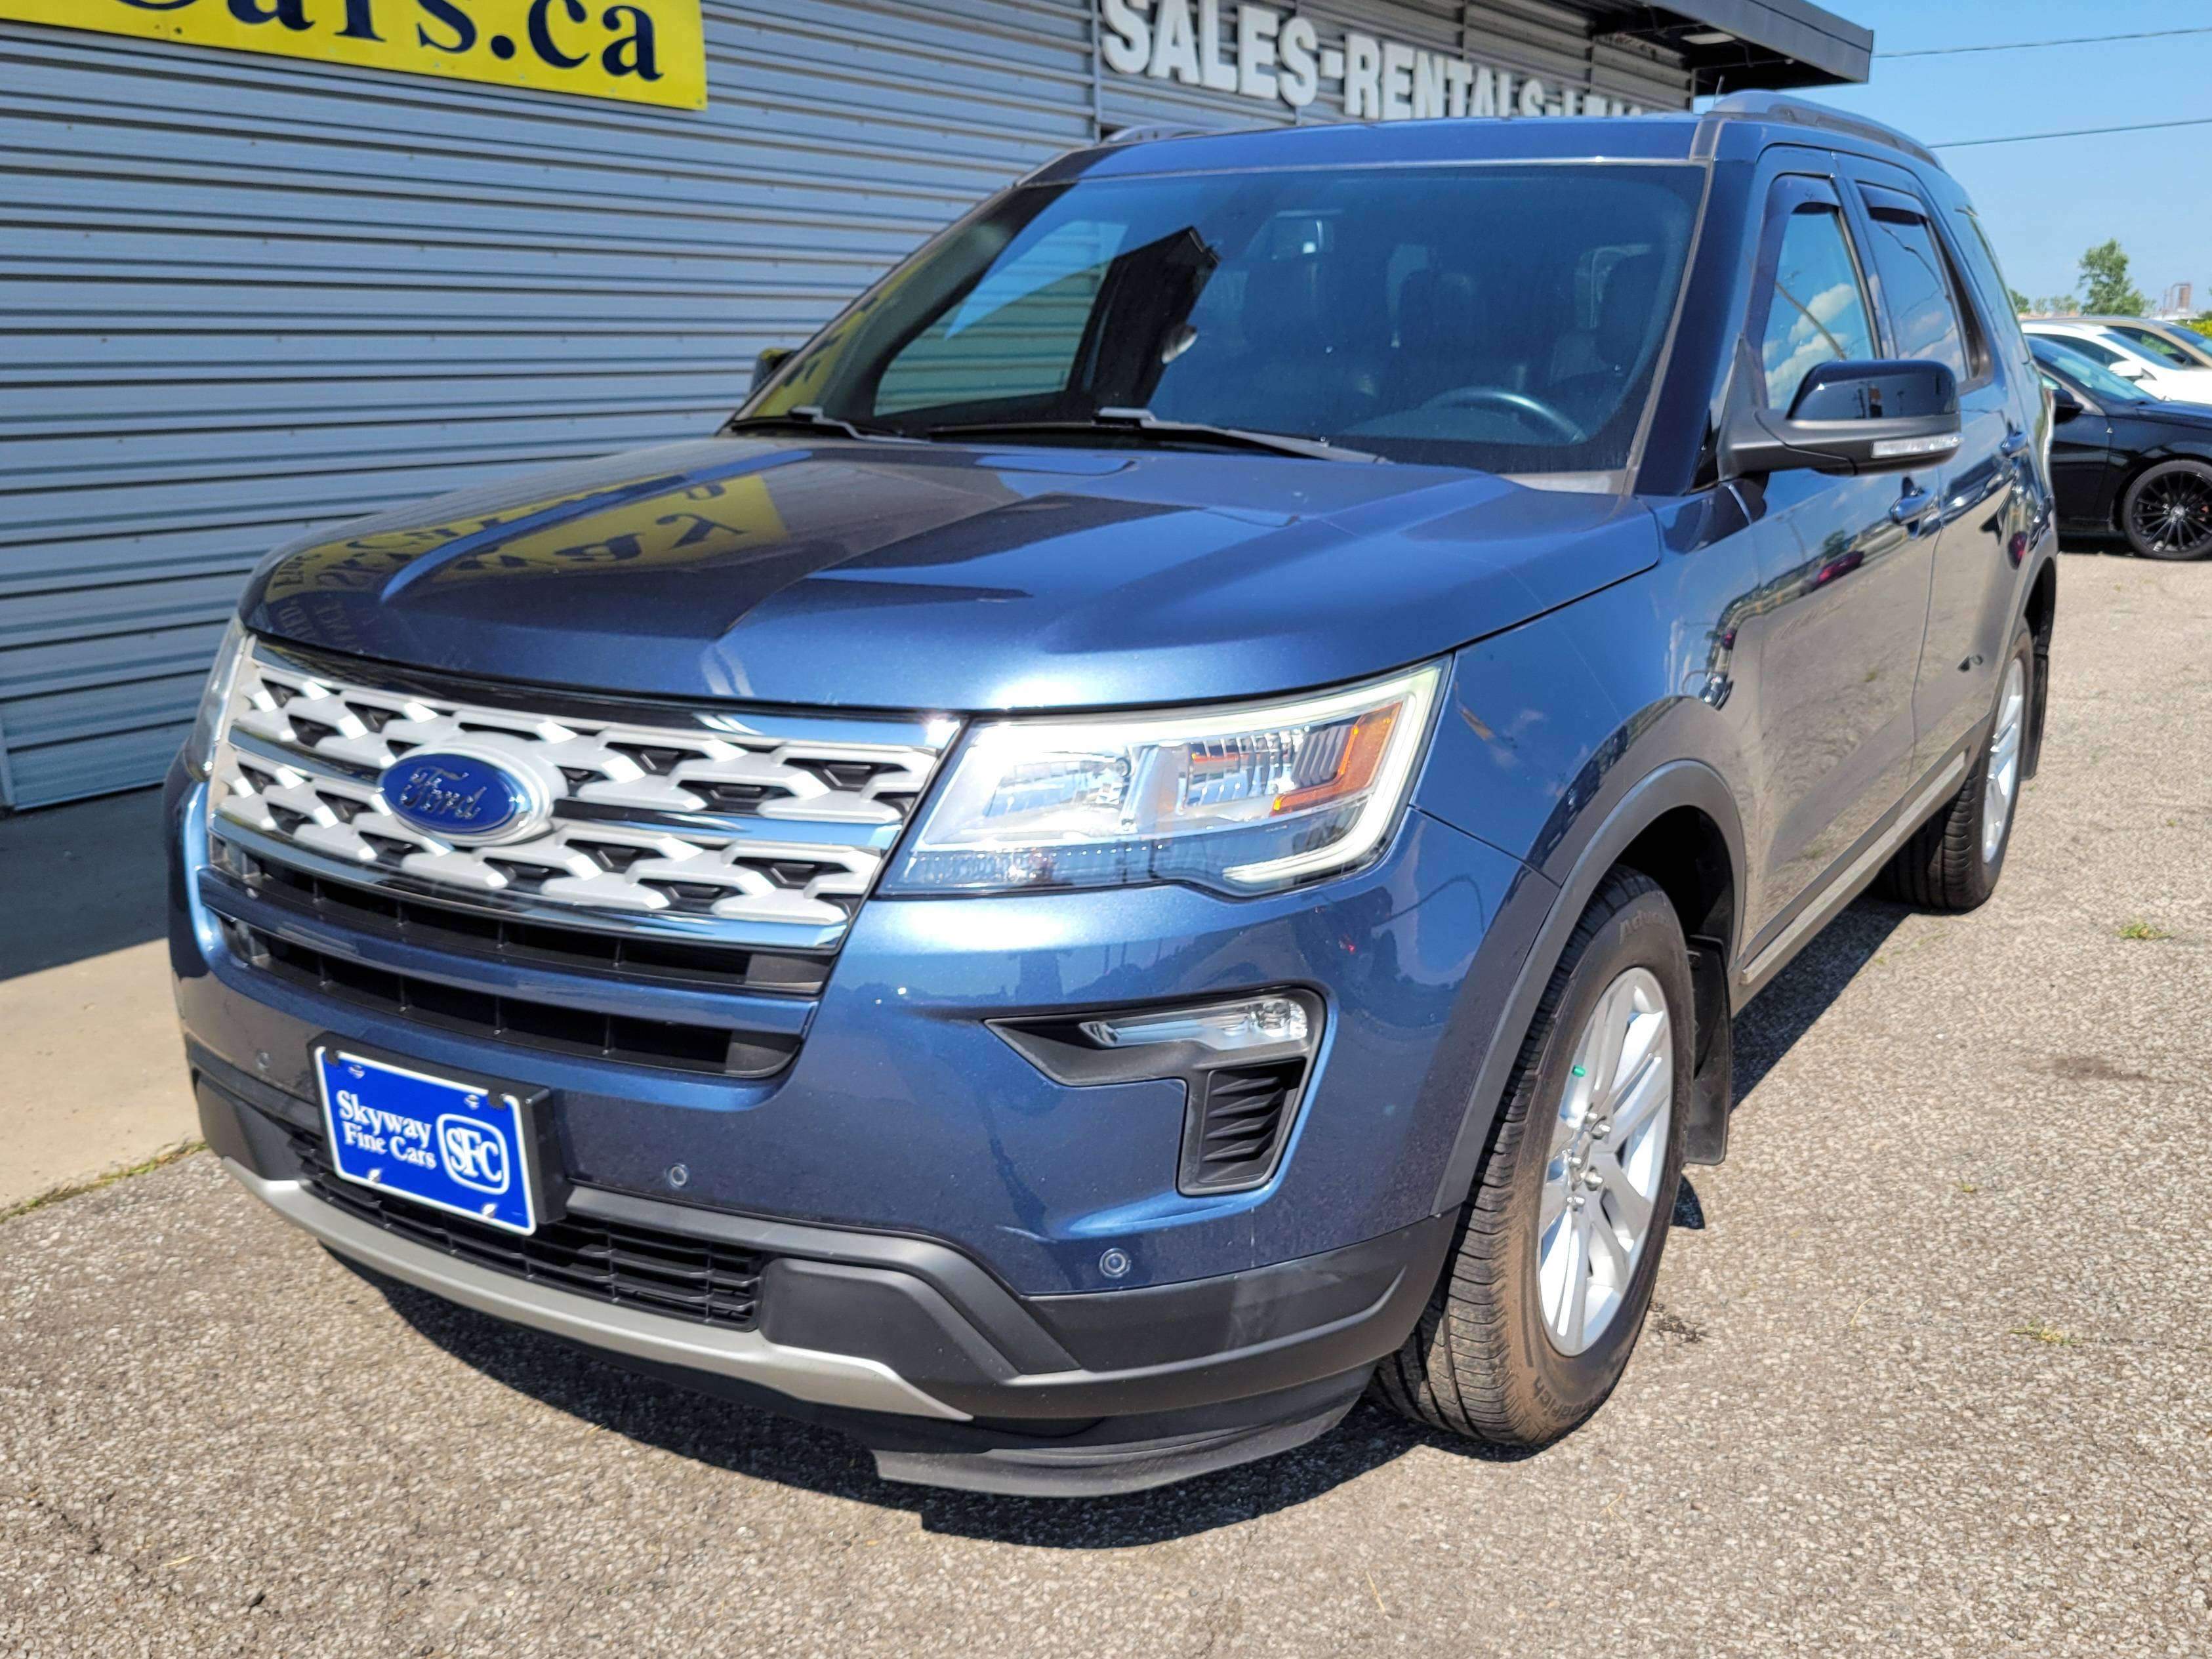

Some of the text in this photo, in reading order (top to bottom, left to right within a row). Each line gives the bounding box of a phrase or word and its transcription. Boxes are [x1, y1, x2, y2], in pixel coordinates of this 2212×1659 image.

[398, 766, 487, 819] Ford
[337, 1090, 432, 1149] Skyway
[343, 1122, 436, 1170] Fine Cars
[445, 1126, 502, 1182] SFC
